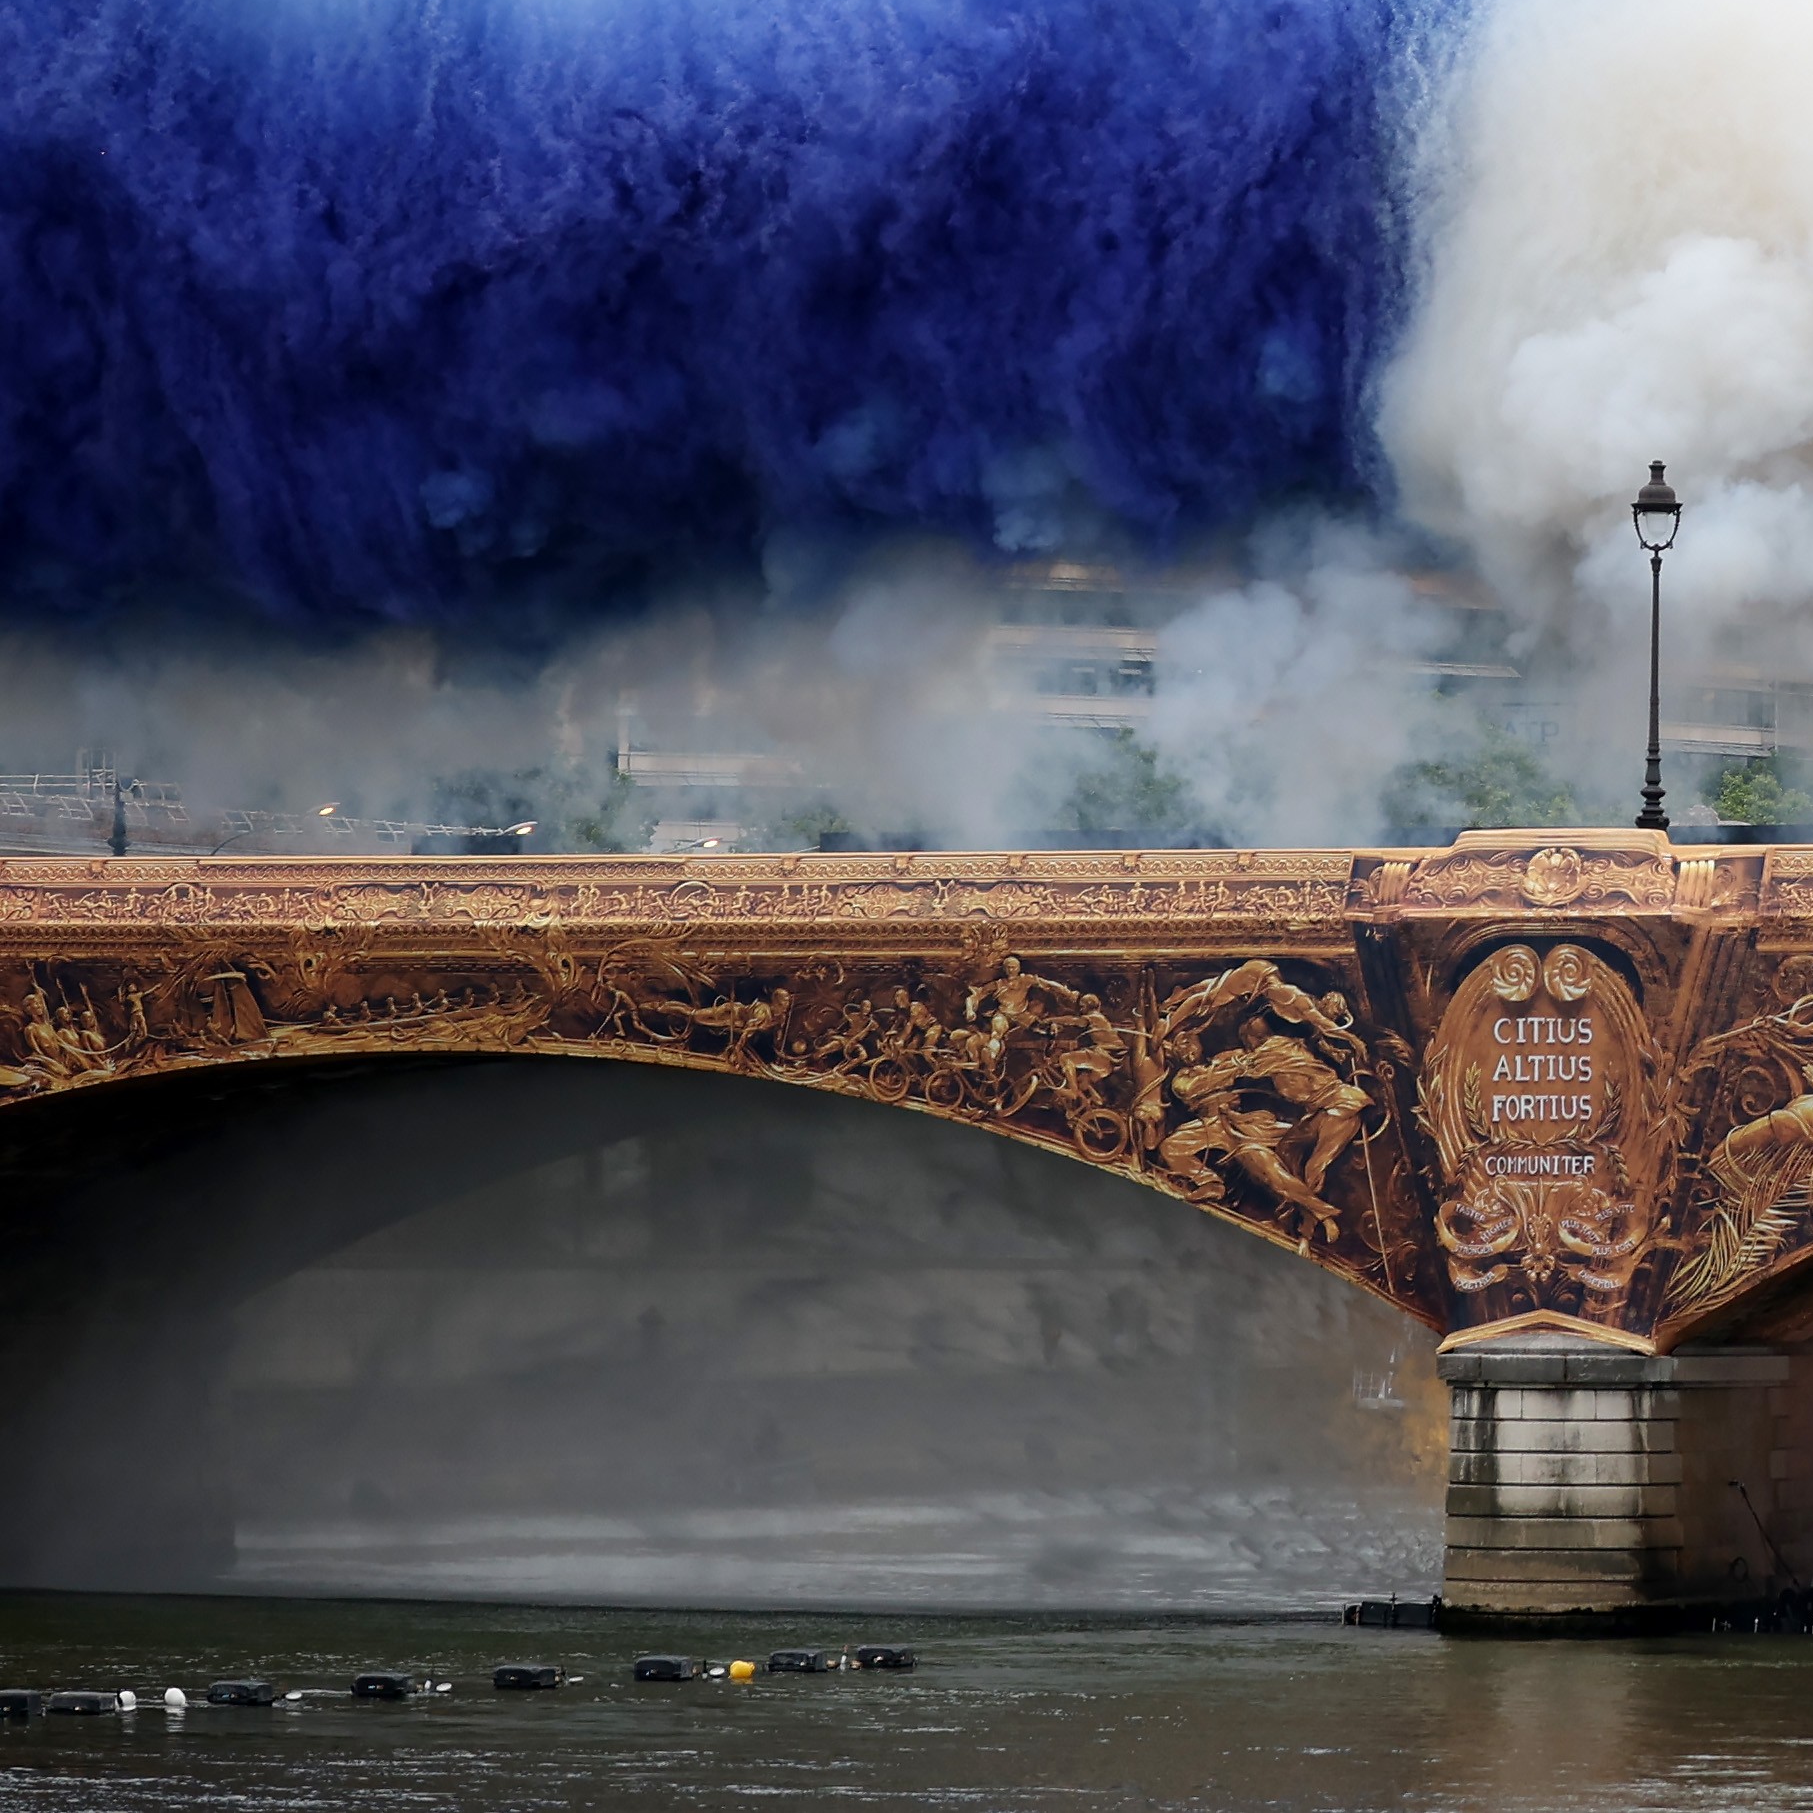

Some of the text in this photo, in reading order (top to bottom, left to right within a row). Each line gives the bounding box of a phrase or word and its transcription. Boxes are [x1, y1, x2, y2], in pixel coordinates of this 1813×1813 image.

[1493, 1017, 1593, 1044] CITIUS
[1492, 1054, 1593, 1082] ALTIUS
[1491, 1094, 1593, 1122] FORTIUS
[1484, 1155, 1596, 1176] COMMUNITER
